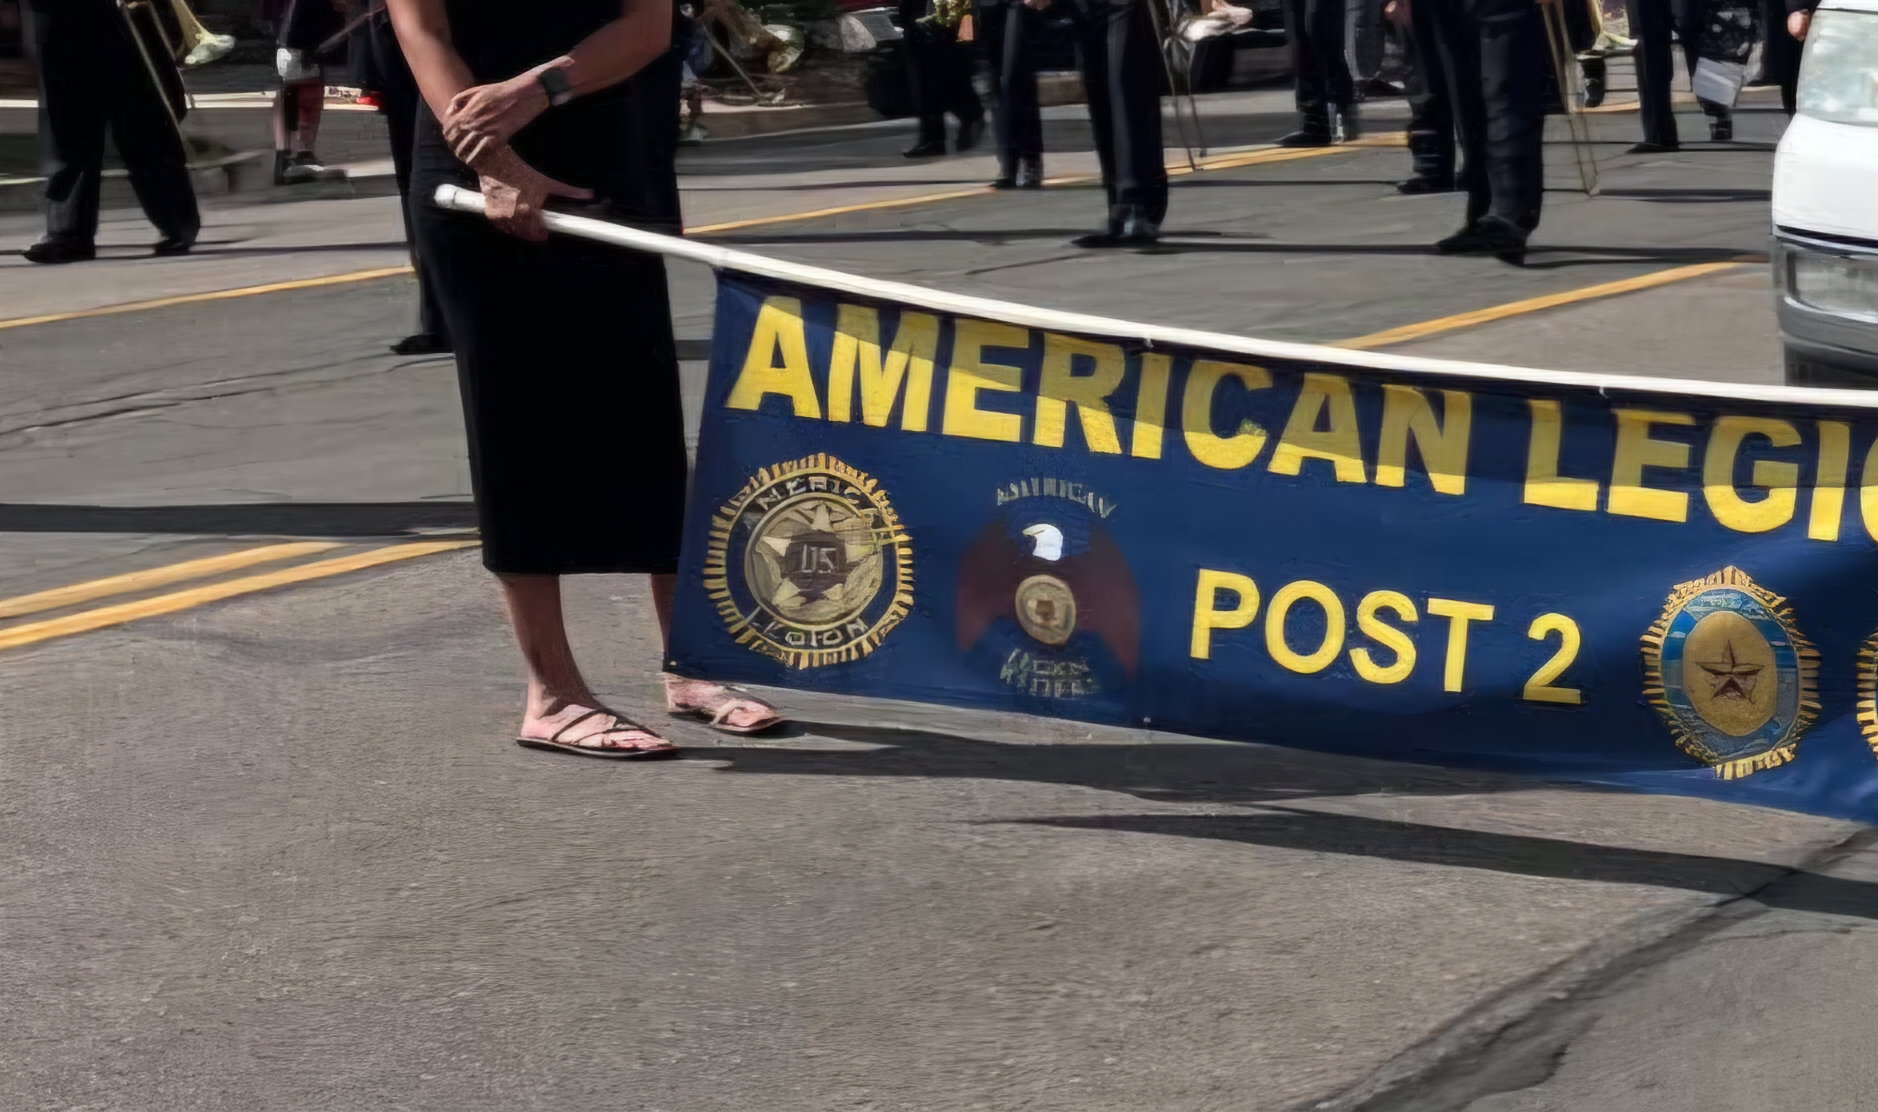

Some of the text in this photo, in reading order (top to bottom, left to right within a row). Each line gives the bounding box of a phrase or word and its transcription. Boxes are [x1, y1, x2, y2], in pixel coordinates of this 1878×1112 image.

[726, 295, 1472, 496] AMERICAN
[1189, 568, 1495, 694] POST
[1524, 612, 1582, 705] 2
